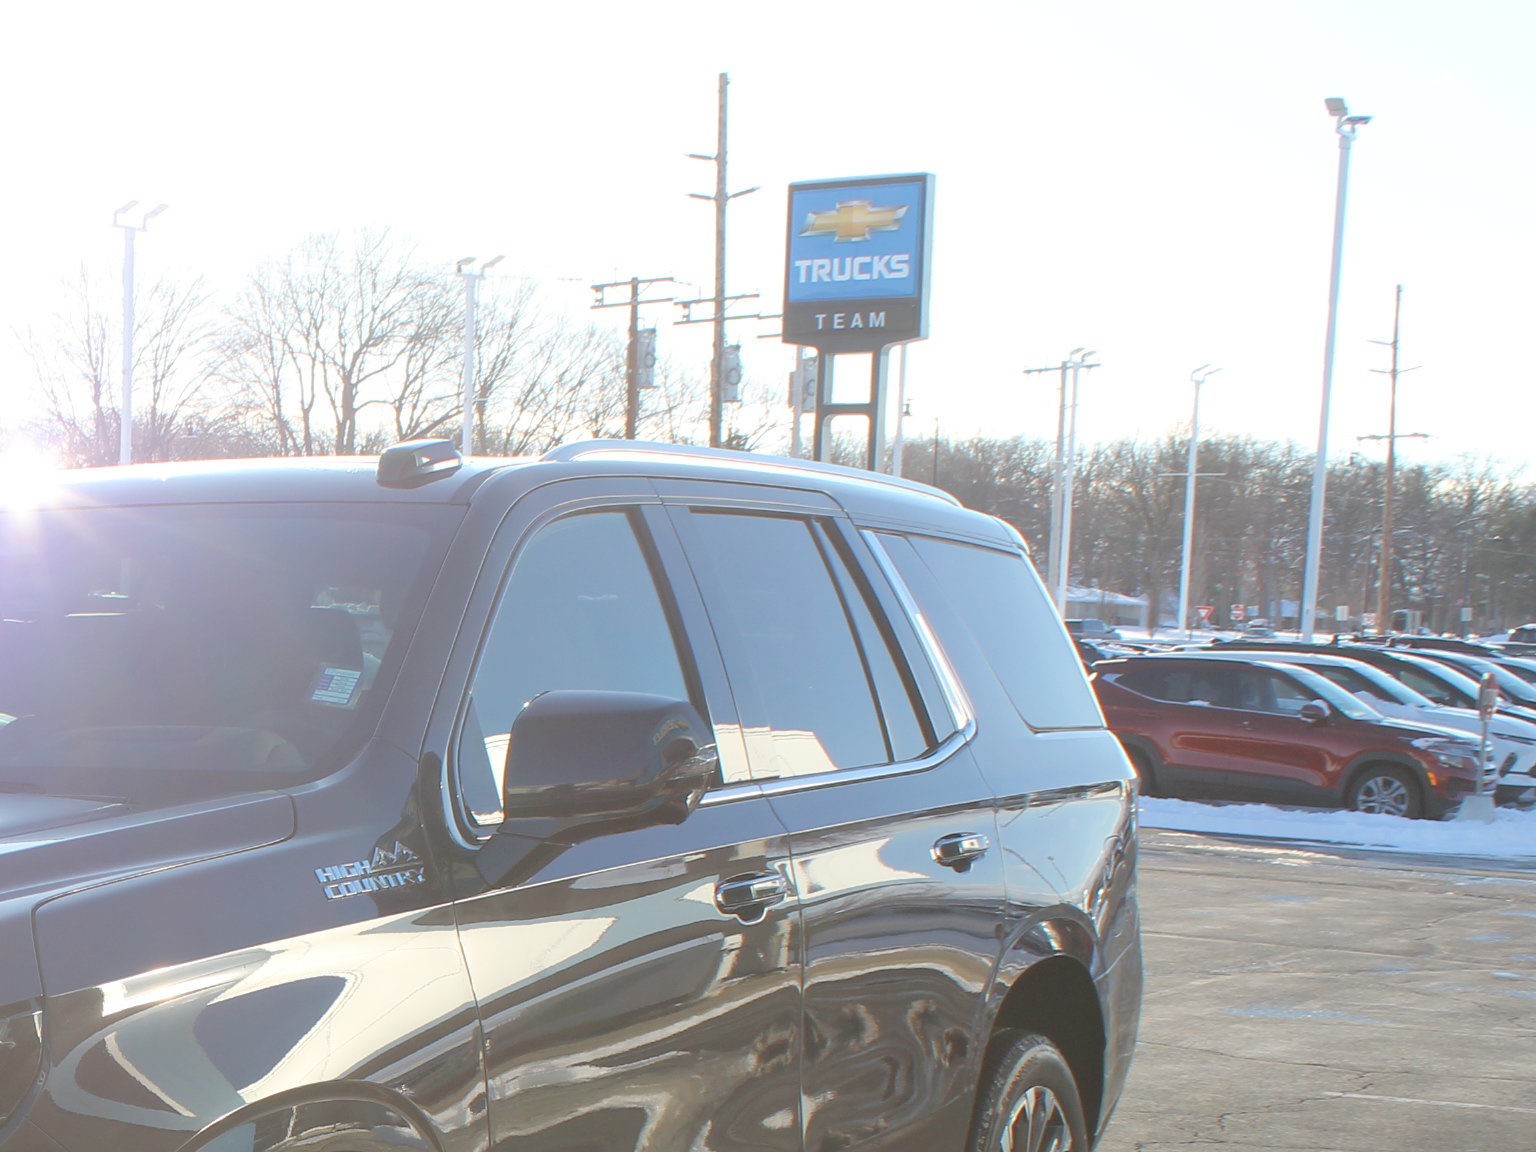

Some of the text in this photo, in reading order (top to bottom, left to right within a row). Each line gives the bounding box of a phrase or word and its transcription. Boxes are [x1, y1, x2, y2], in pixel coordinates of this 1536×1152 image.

[794, 254, 910, 283] TRUCKS
[815, 312, 886, 330] TEAM
[314, 860, 372, 883] HIGH
[322, 867, 426, 899] COUNTRY
